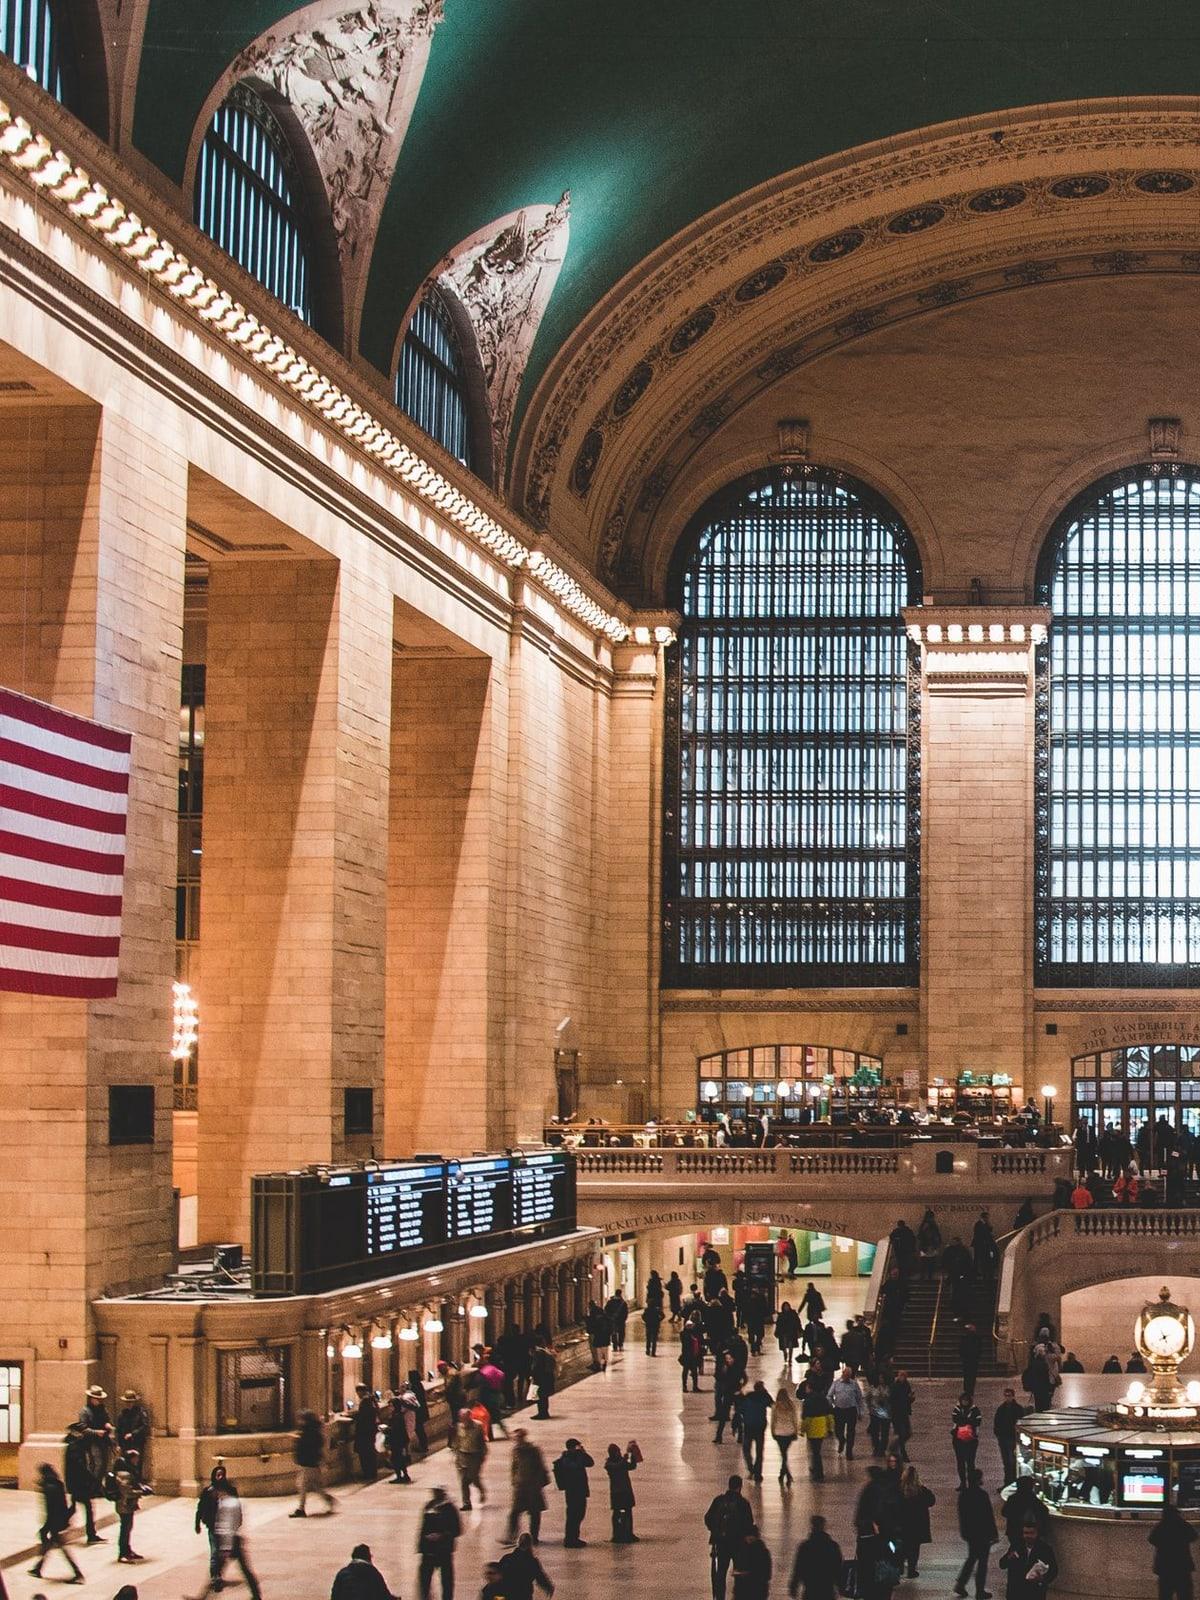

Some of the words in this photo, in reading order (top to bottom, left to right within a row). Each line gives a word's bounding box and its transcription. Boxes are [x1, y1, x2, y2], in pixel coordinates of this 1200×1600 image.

[1092, 1028, 1107, 1039] TO
[1113, 1021, 1186, 1033] VANDERBILT
[1082, 1038, 1107, 1050] THE
[1112, 1031, 1172, 1044] CAMPBELL
[642, 1210, 706, 1226] MACHINES
[746, 1211, 793, 1224] SUBWAY
[801, 1217, 832, 1230] 42ND
[835, 1223, 848, 1233] ST
